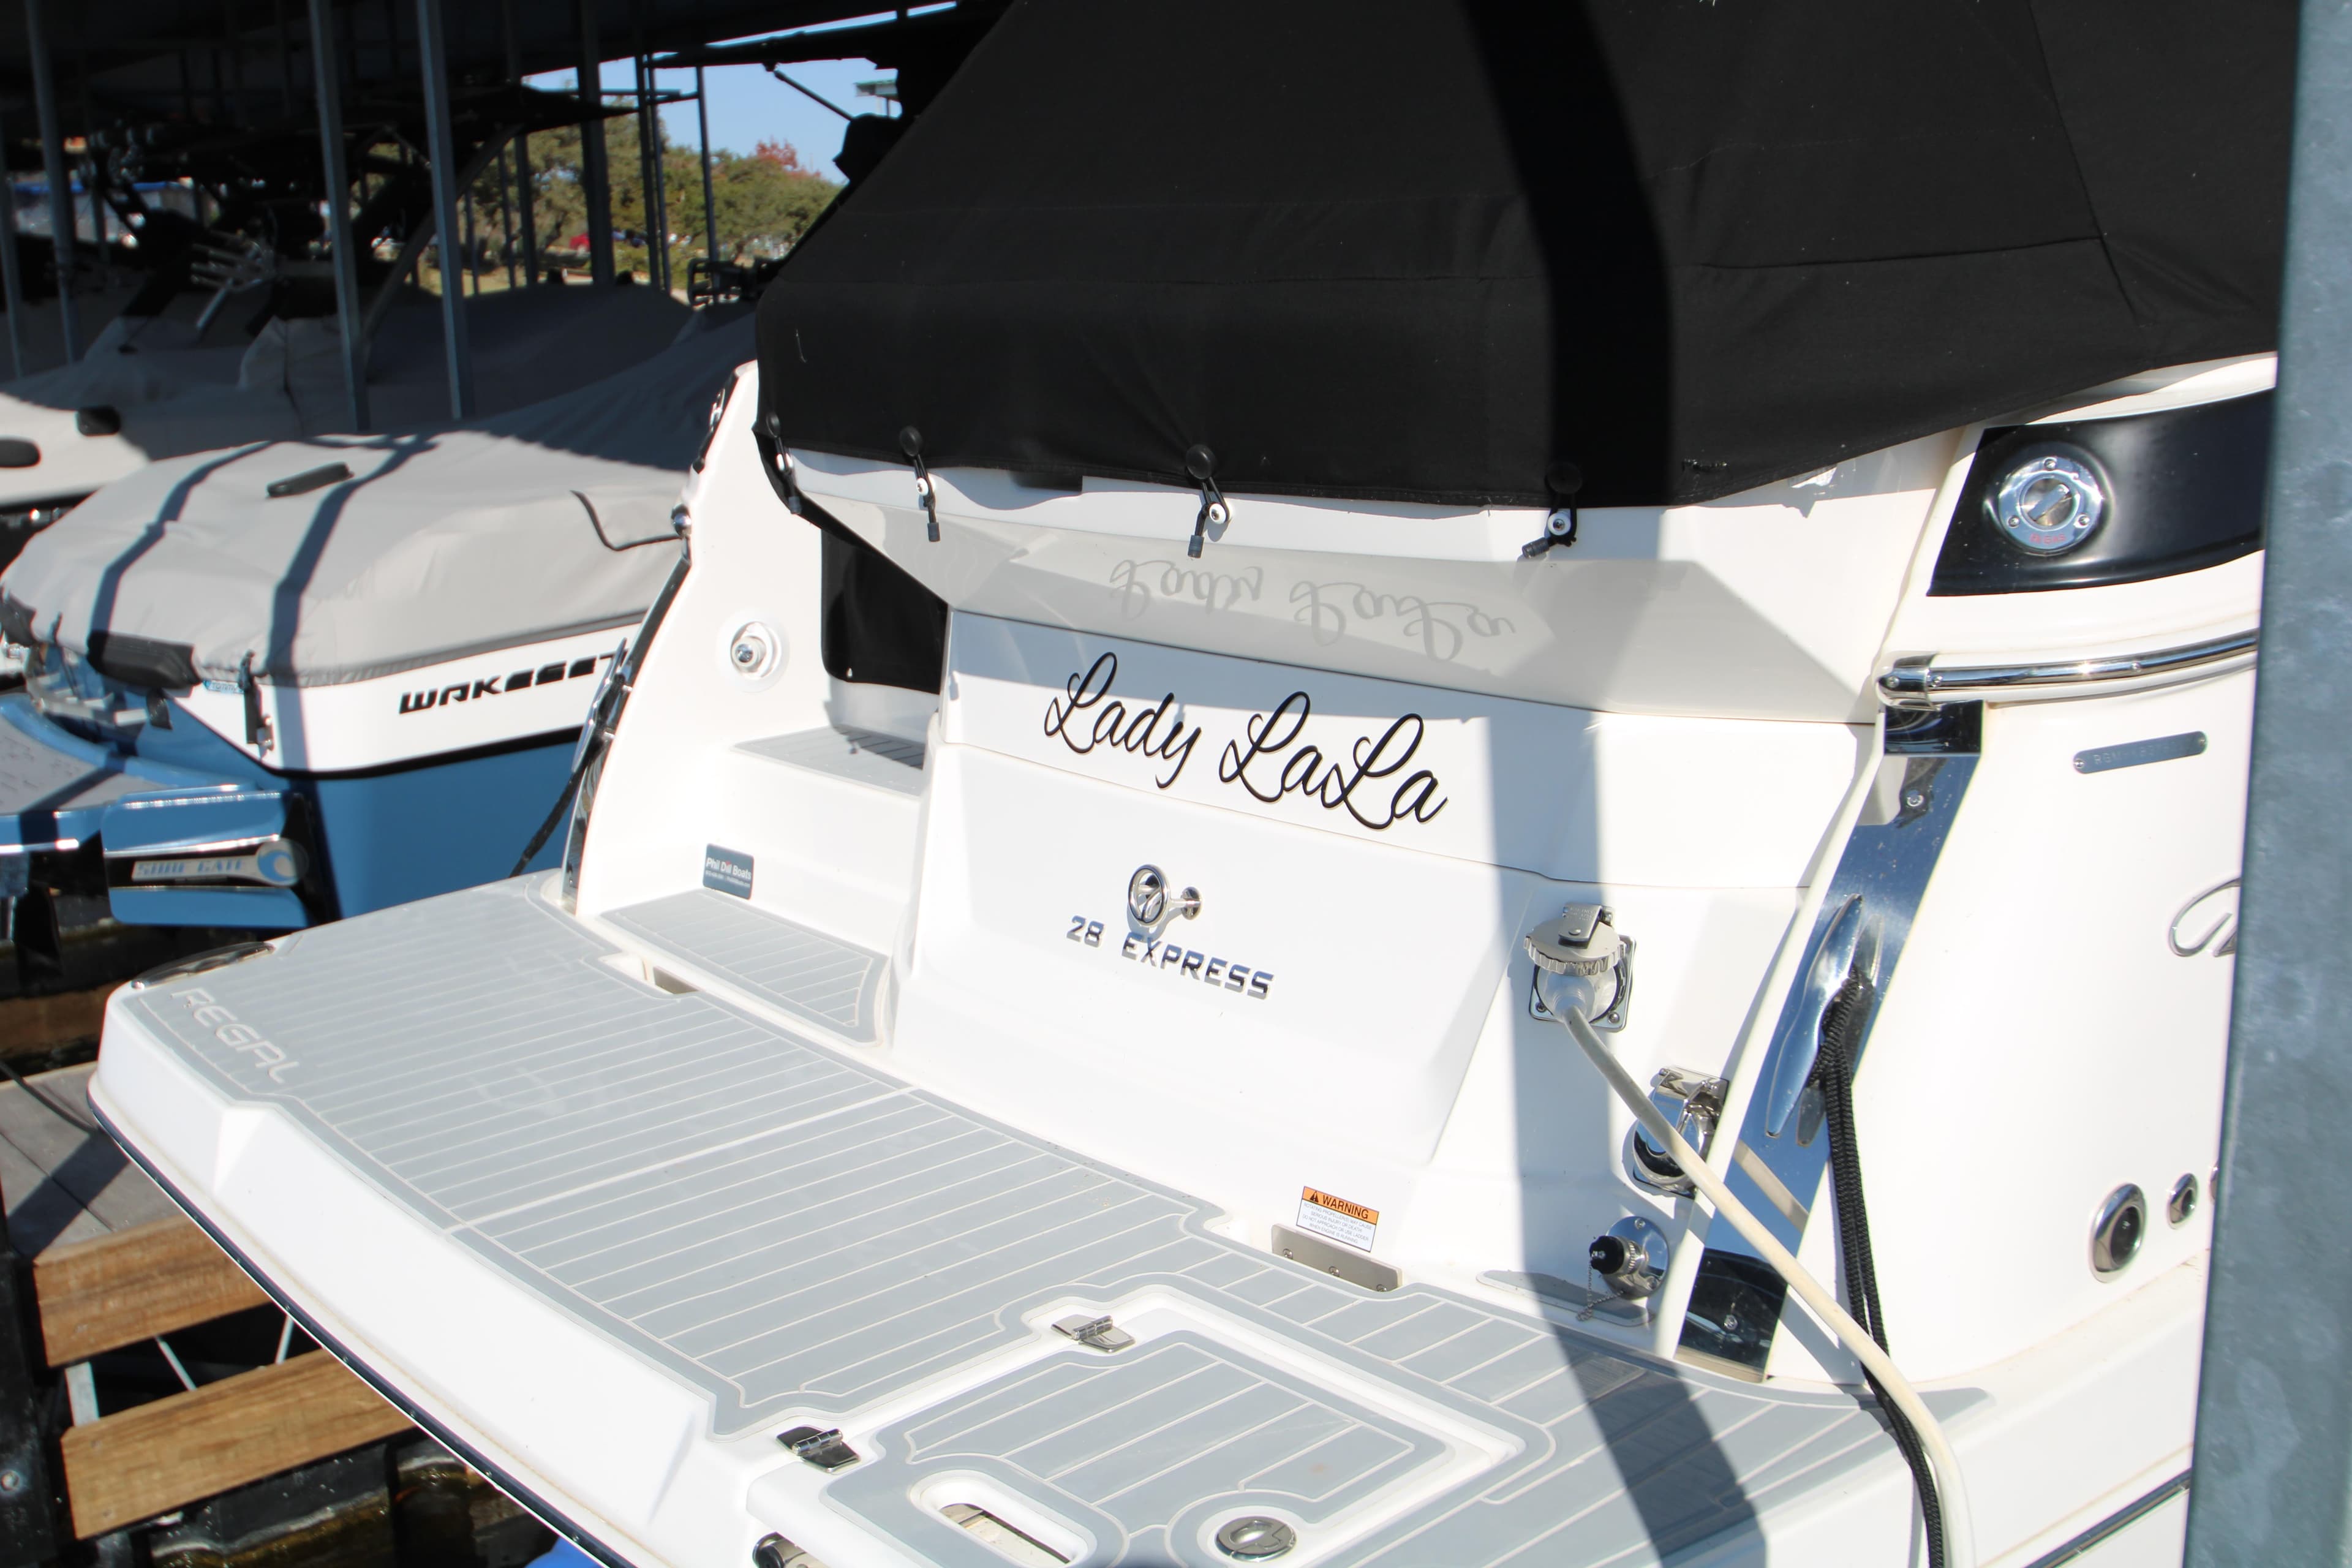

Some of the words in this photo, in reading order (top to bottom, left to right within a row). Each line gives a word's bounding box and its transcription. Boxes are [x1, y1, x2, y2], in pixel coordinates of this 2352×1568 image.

[1044, 652, 1202, 790] Lady
[1218, 691, 1449, 830] LaLa
[706, 858, 720, 870] Phil
[720, 861, 733, 873] Dill
[733, 865, 752, 880] Boats
[1066, 915, 1105, 948] 28
[1121, 932, 1275, 1000] EXPRESS
[169, 987, 300, 1084] REGAL
[1322, 1194, 1370, 1219] WARNING
